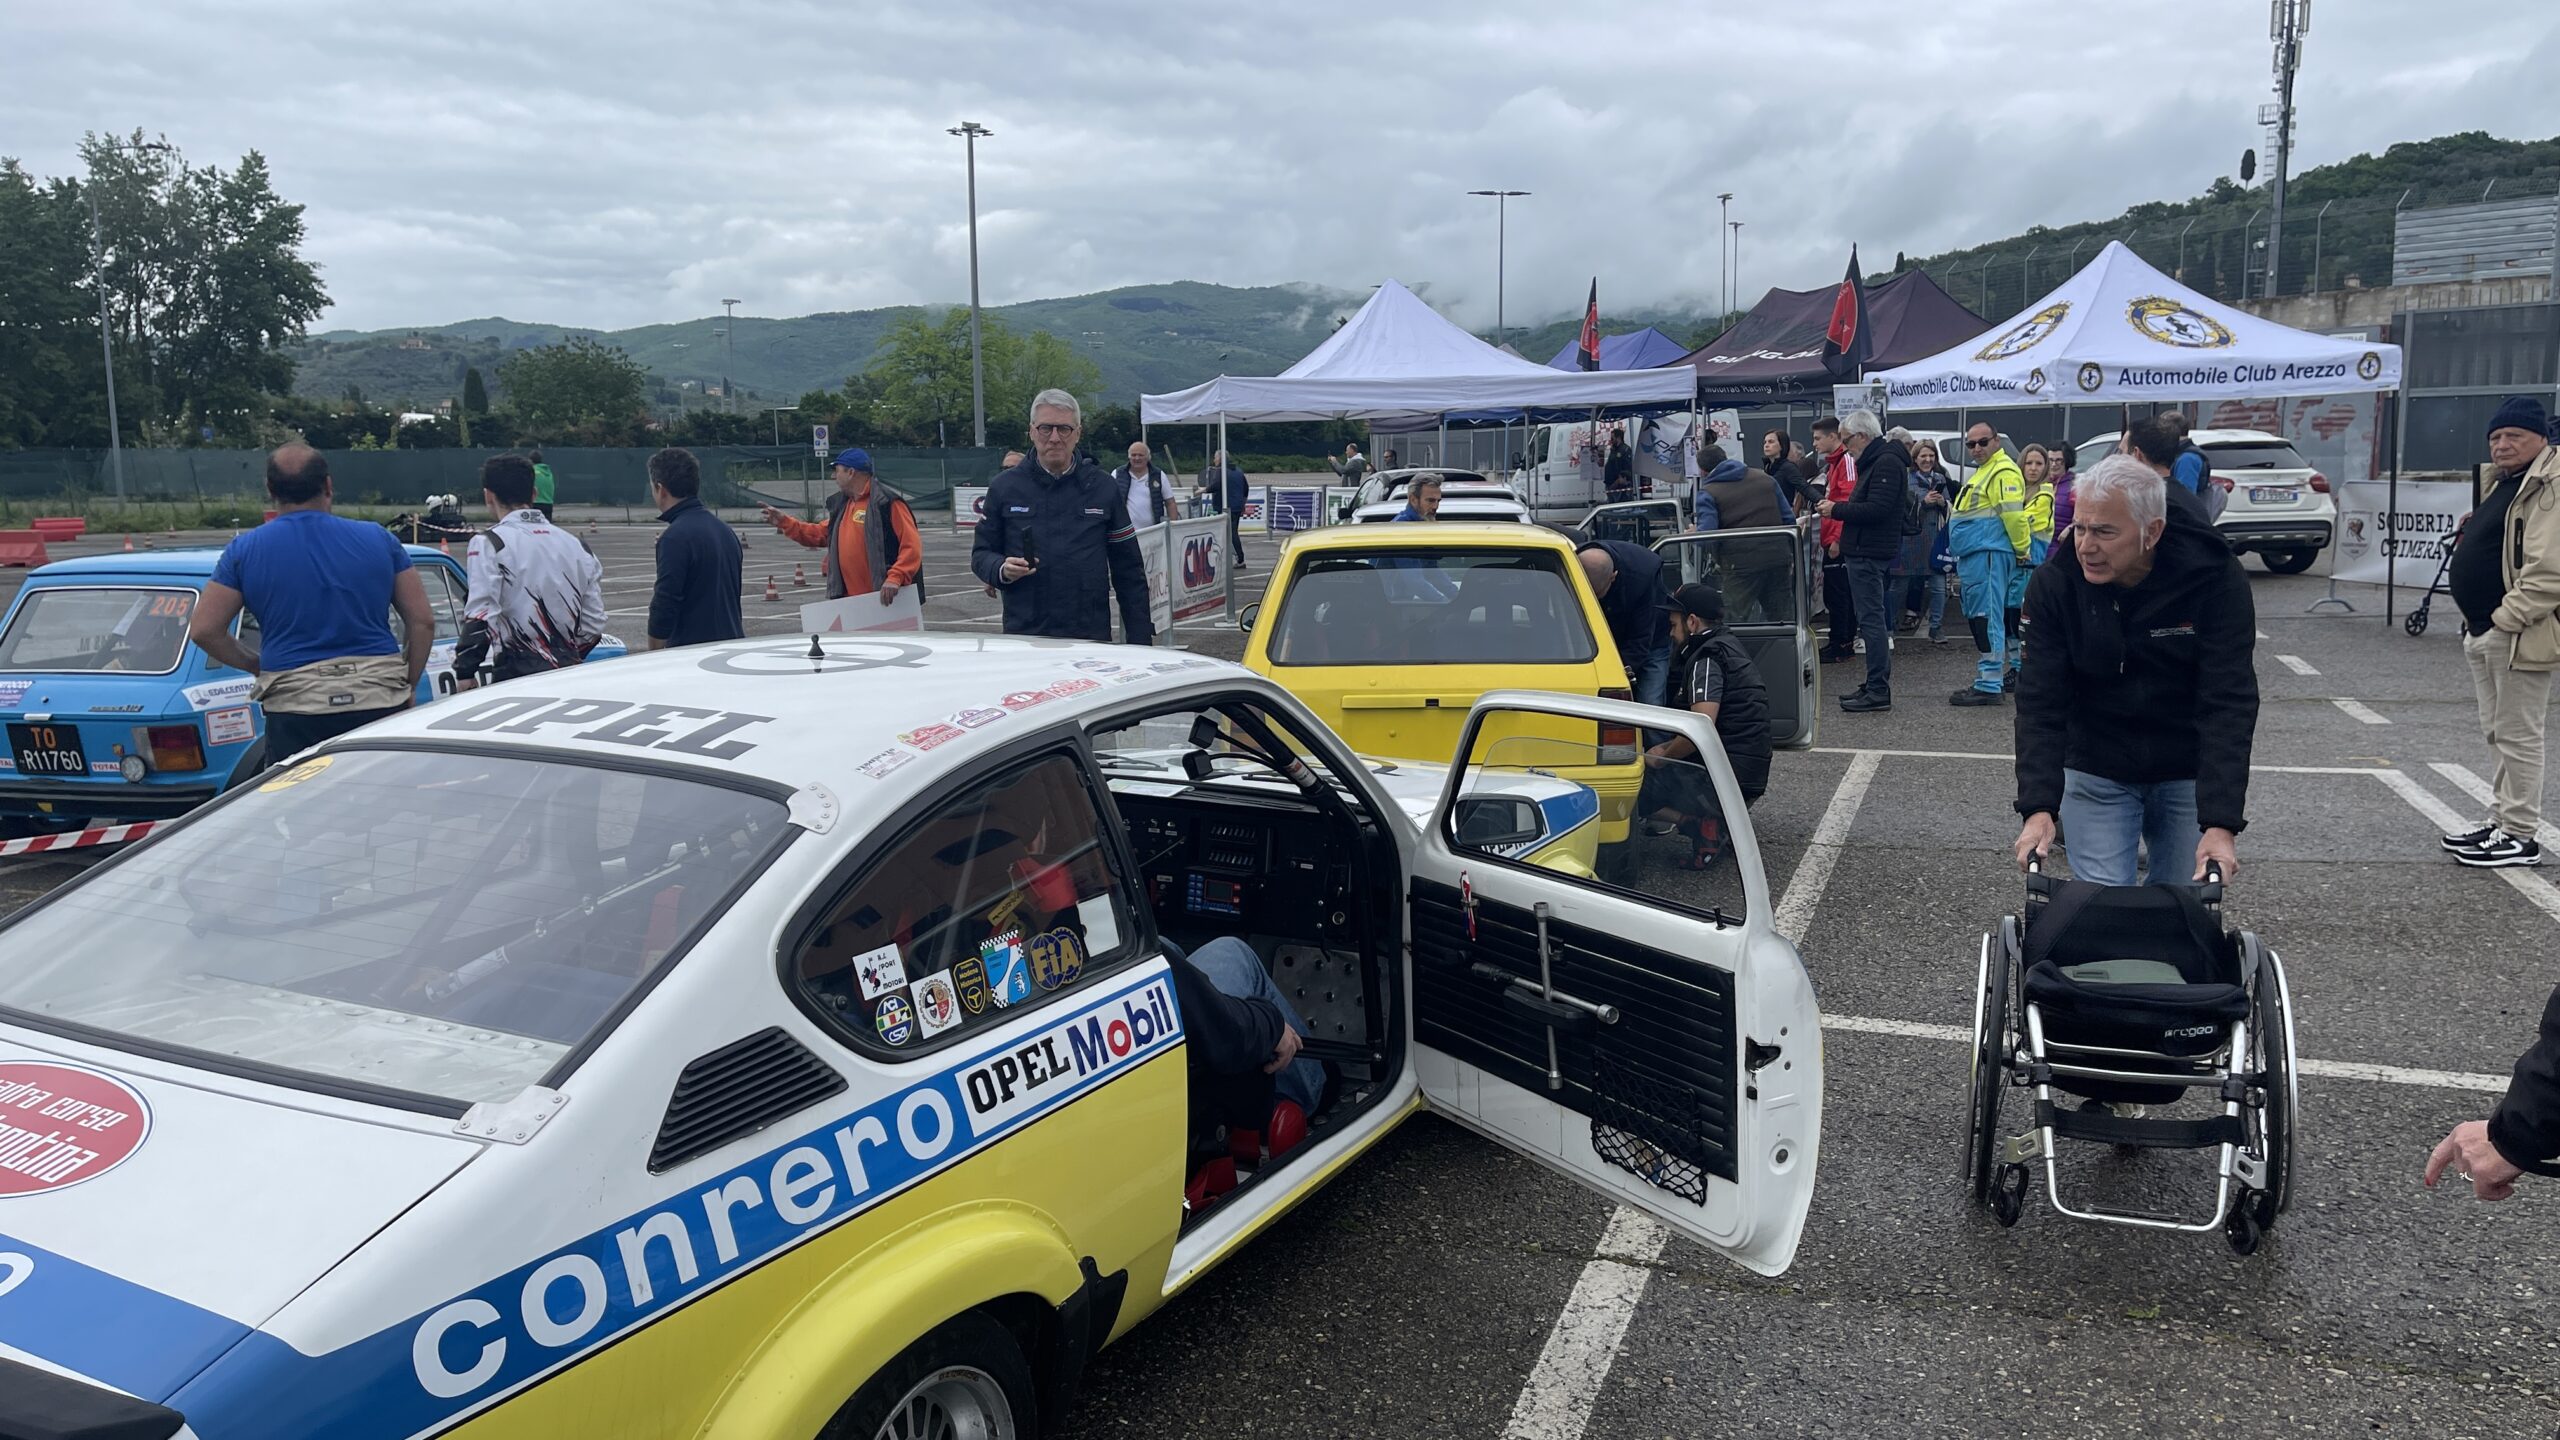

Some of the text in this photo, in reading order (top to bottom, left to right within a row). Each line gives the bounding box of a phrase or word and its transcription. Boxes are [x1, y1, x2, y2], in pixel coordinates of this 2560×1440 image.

[2118, 362, 2347, 386] Automobile Club Arezzo
[1890, 377, 1948, 398] Automobile
[1950, 376, 1977, 393] Club
[1183, 536, 1216, 589] CMC
[149, 595, 191, 616] 205
[30, 727, 57, 749] TO
[427, 697, 777, 761] OPEL
[23, 750, 83, 772] R11760
[882, 998, 899, 1014] ACI
[967, 986, 1174, 1114] OPEL Mobil
[0, 1079, 129, 1132] adra corse
[413, 1087, 954, 1398] conrero
